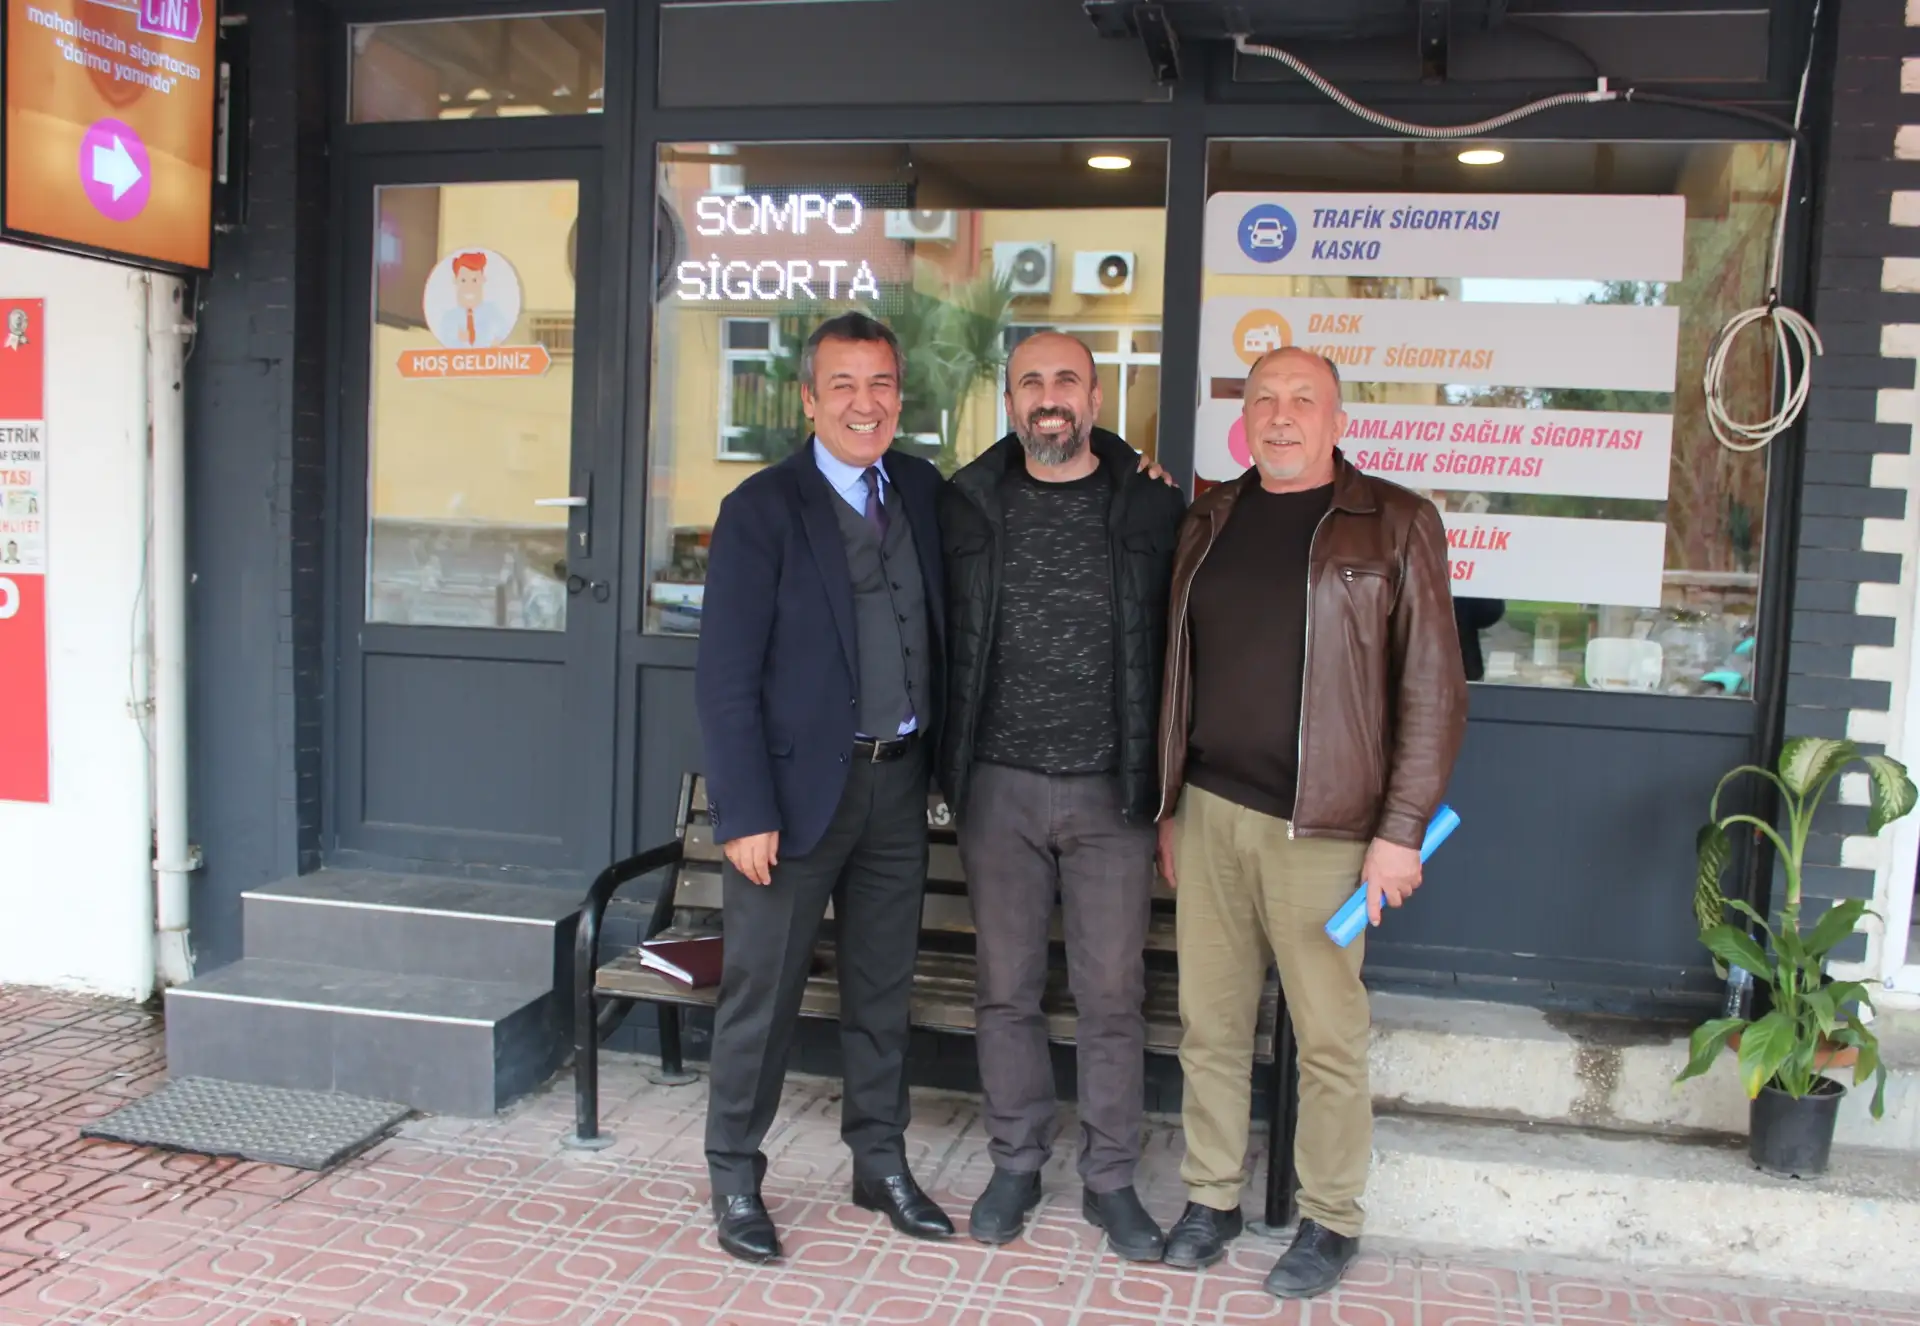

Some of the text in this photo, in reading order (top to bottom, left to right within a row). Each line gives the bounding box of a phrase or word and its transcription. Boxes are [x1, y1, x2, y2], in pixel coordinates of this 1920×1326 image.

[27, 6, 200, 80] mahallenizin sigortacısı
[696, 193, 863, 236] SOMPO
[1312, 205, 1500, 230] TRAFİK SİGORTASI
[1311, 240, 1381, 260] KASKO
[676, 252, 880, 300] SİGORTA
[1307, 313, 1363, 334] DASK
[412, 352, 532, 376] HOŞ GELDİNİZ
[1384, 343, 1495, 370] SİGORTASI
[0, 423, 39, 443] ETRİK
[1344, 418, 1644, 450] AMLAYICI SAĞLIK SİGORTASI
[1354, 444, 1544, 477] SAĞLIK SİGORTASI
[1447, 524, 1512, 550] KLİLİK
